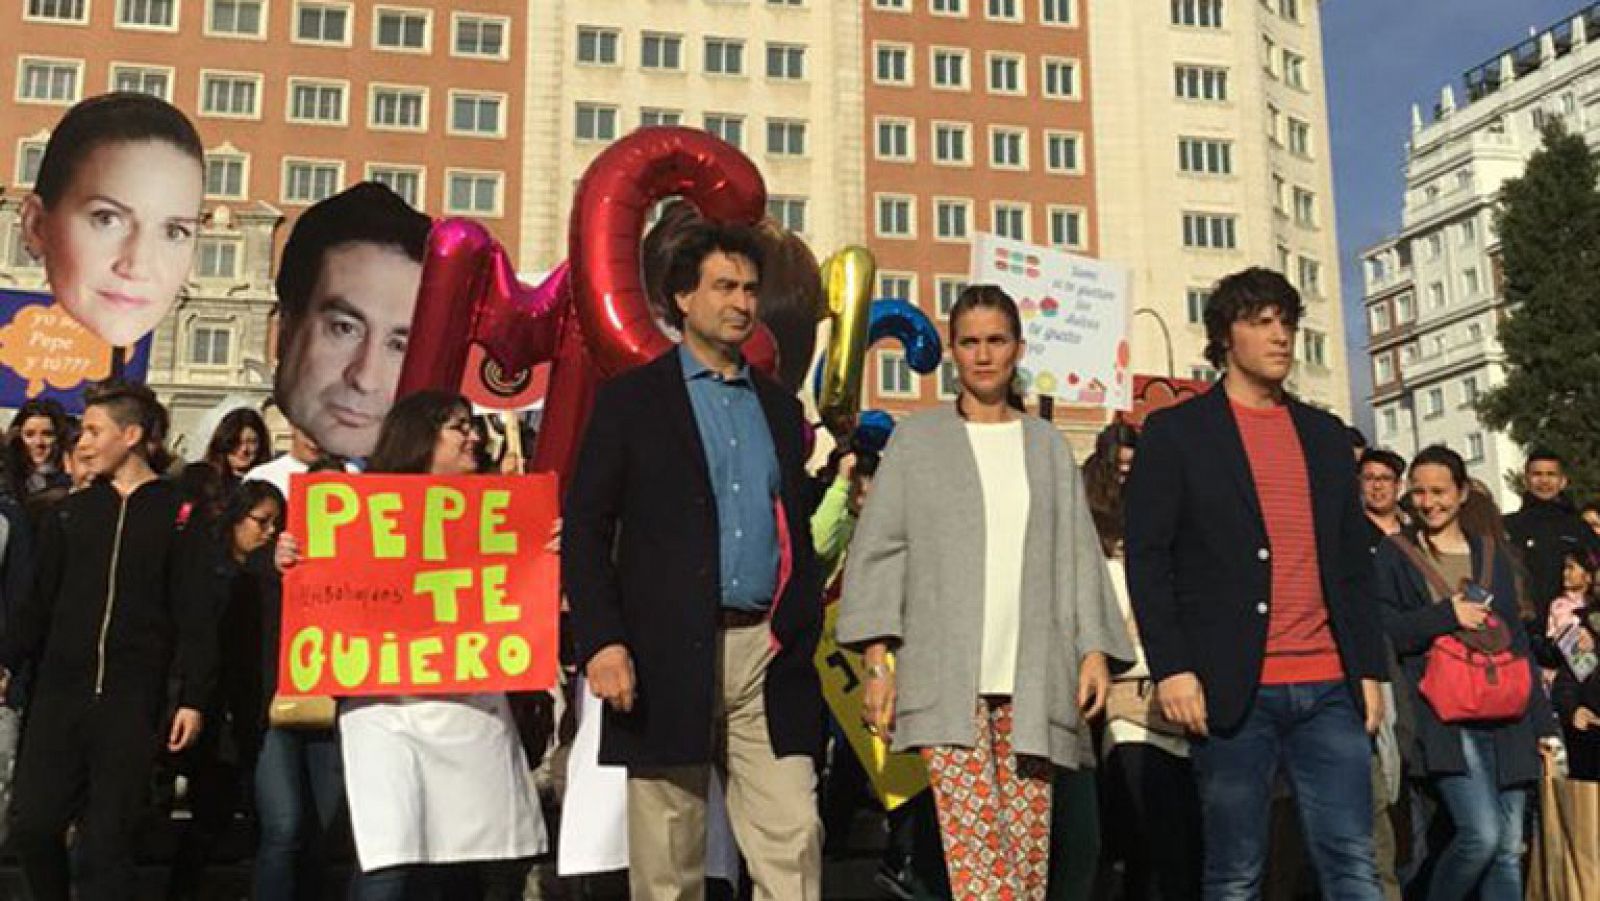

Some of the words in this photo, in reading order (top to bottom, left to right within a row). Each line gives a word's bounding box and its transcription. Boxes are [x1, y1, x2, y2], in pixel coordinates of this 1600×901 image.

[29, 331, 74, 352] Pepe
[26, 357, 37, 371] y
[307, 482, 518, 560] PEPE
[412, 565, 521, 623] TE
